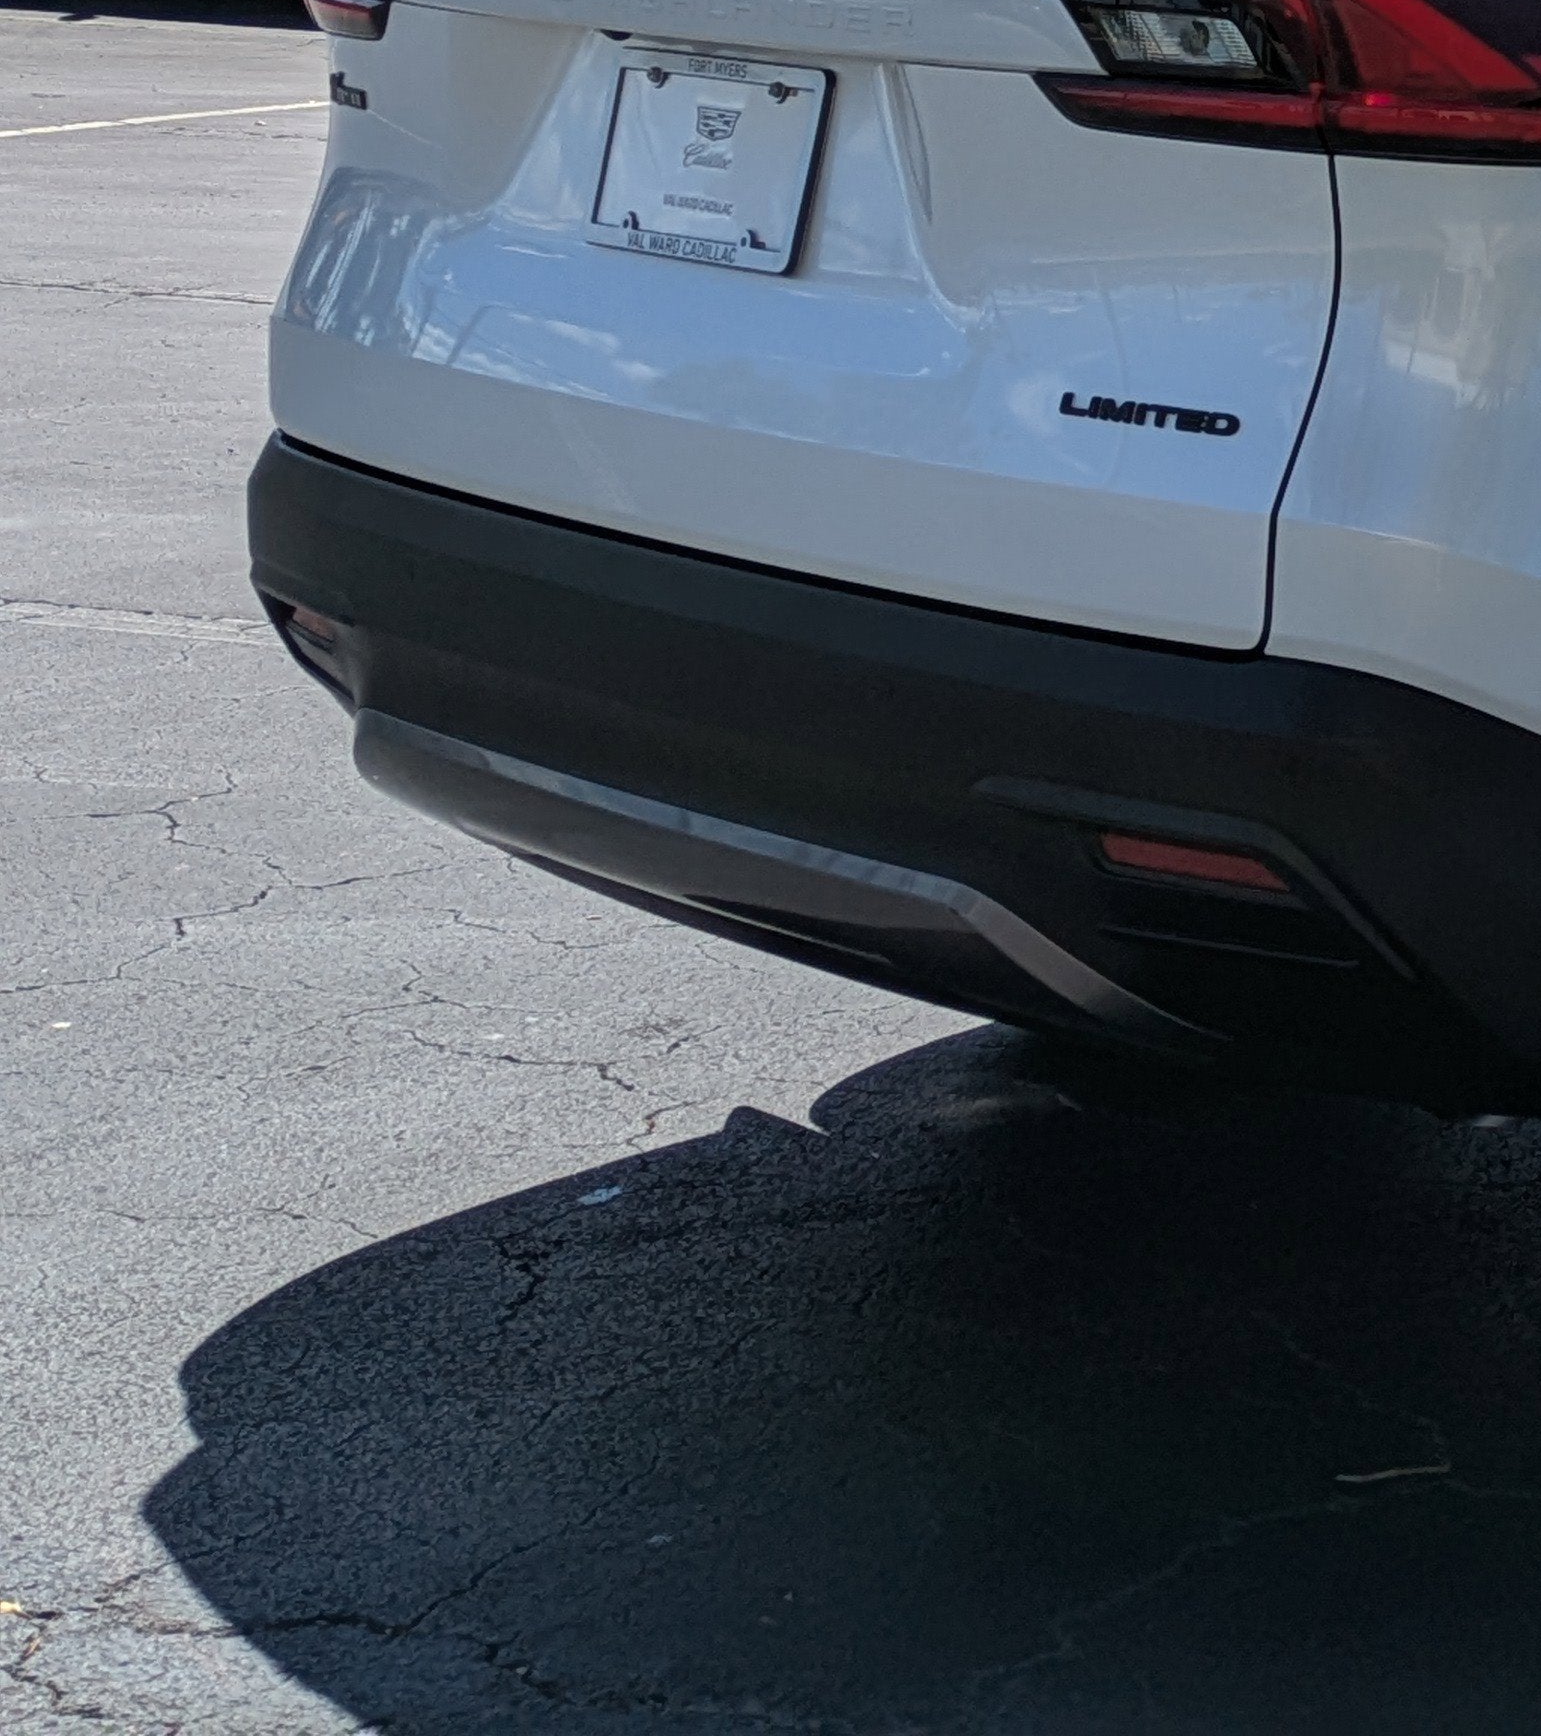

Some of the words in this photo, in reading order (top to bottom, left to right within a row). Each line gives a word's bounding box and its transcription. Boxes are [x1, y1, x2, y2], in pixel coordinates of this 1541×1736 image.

[688, 58, 713, 74] FORT
[714, 61, 749, 79] MYERS
[627, 232, 645, 250] VAL
[649, 234, 681, 255] WARD
[682, 240, 738, 264] CADILLAC
[1059, 392, 1241, 437] LIMITED
